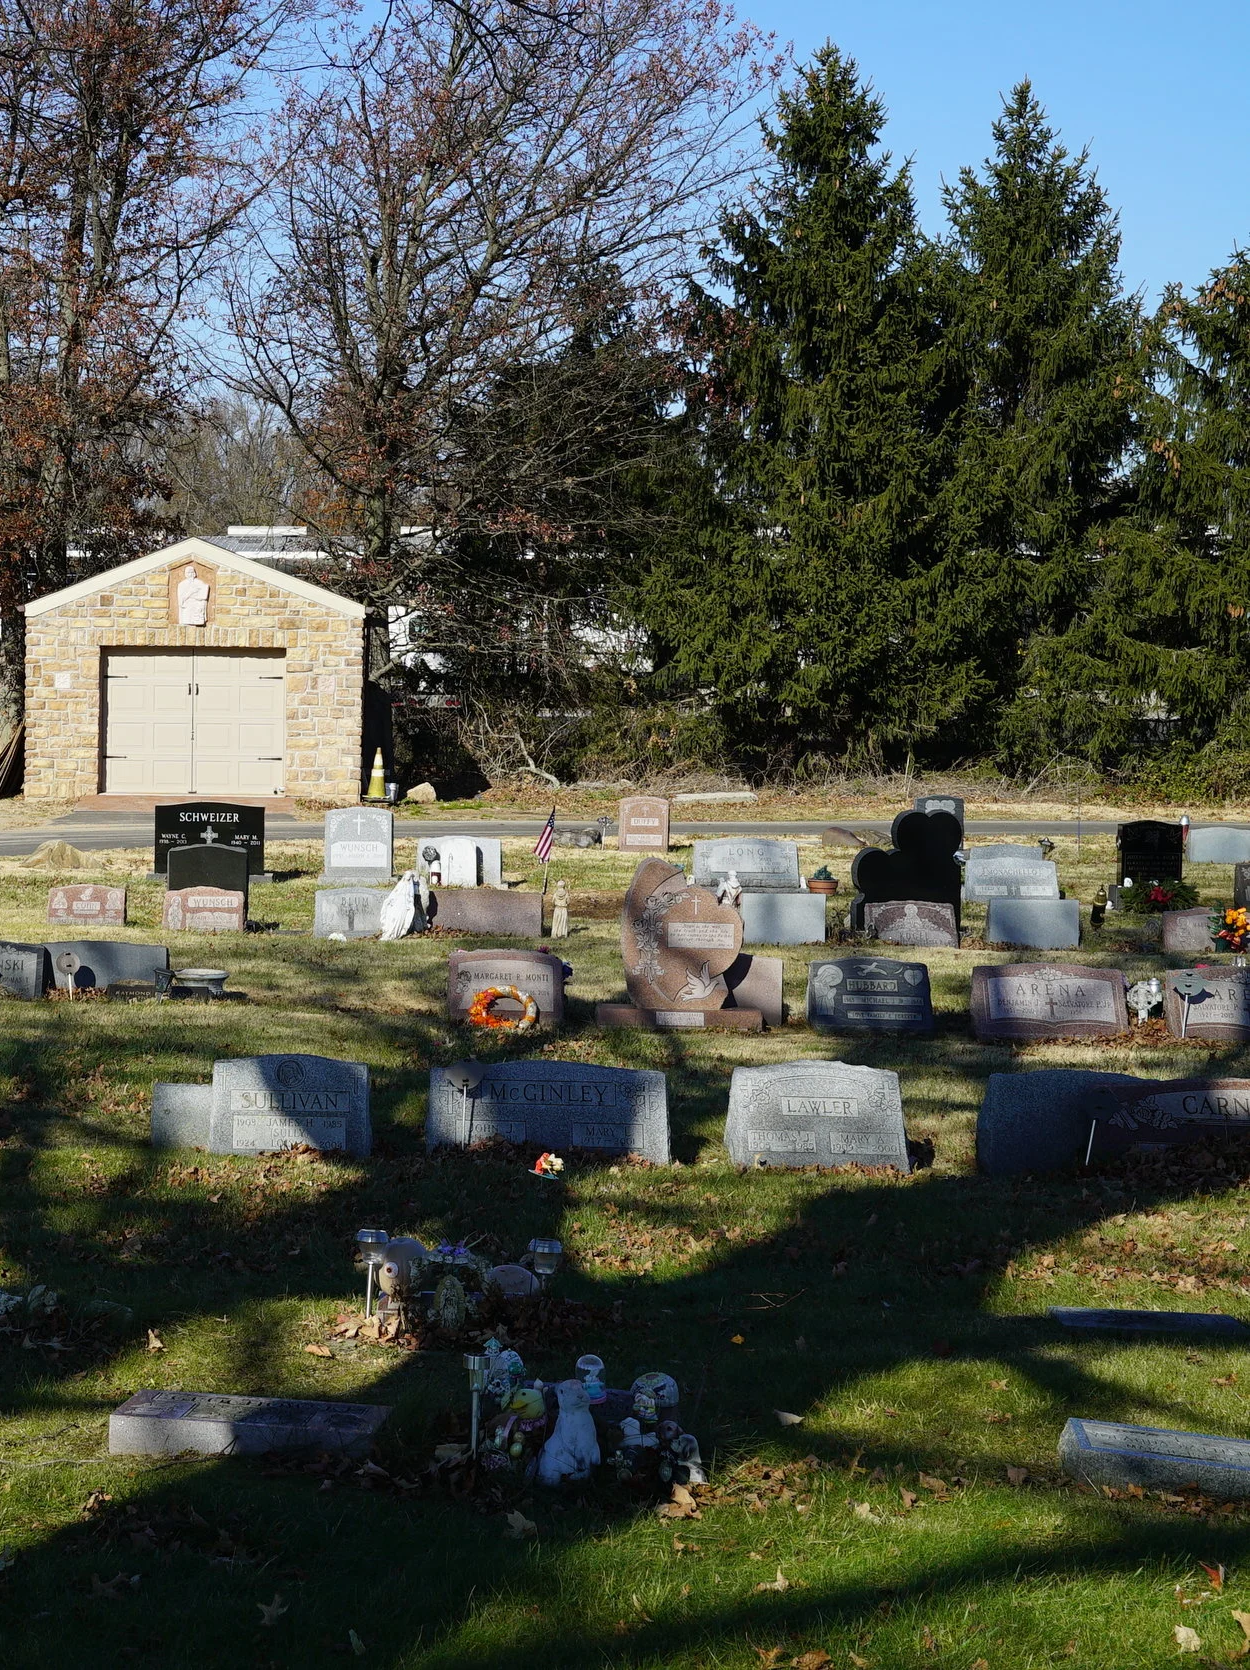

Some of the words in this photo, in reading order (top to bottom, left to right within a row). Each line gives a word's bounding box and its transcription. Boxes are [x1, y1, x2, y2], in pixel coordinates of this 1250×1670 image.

[179, 812, 240, 823] SCHWEIZER
[340, 843, 378, 853] WUNSCH
[728, 847, 765, 857] LONG
[193, 897, 233, 907] WUNSCH
[341, 896, 370, 905] BLUM
[473, 972, 512, 982] MARGARET
[526, 973, 550, 982] MONTI
[848, 980, 897, 991] HUBBARD
[1016, 983, 1087, 997] ARENA
[490, 1083, 609, 1103] McGINLEY
[241, 1091, 340, 1110] SULLIVAN
[1182, 1095, 1250, 1117] CARN
[787, 1099, 853, 1115] LAWLER
[266, 1118, 301, 1127] JAMES
[586, 1126, 616, 1137] MARY
[236, 1139, 256, 1147] 1924
[752, 1131, 798, 1142] THOMAS
[839, 1134, 870, 1144] MARY
